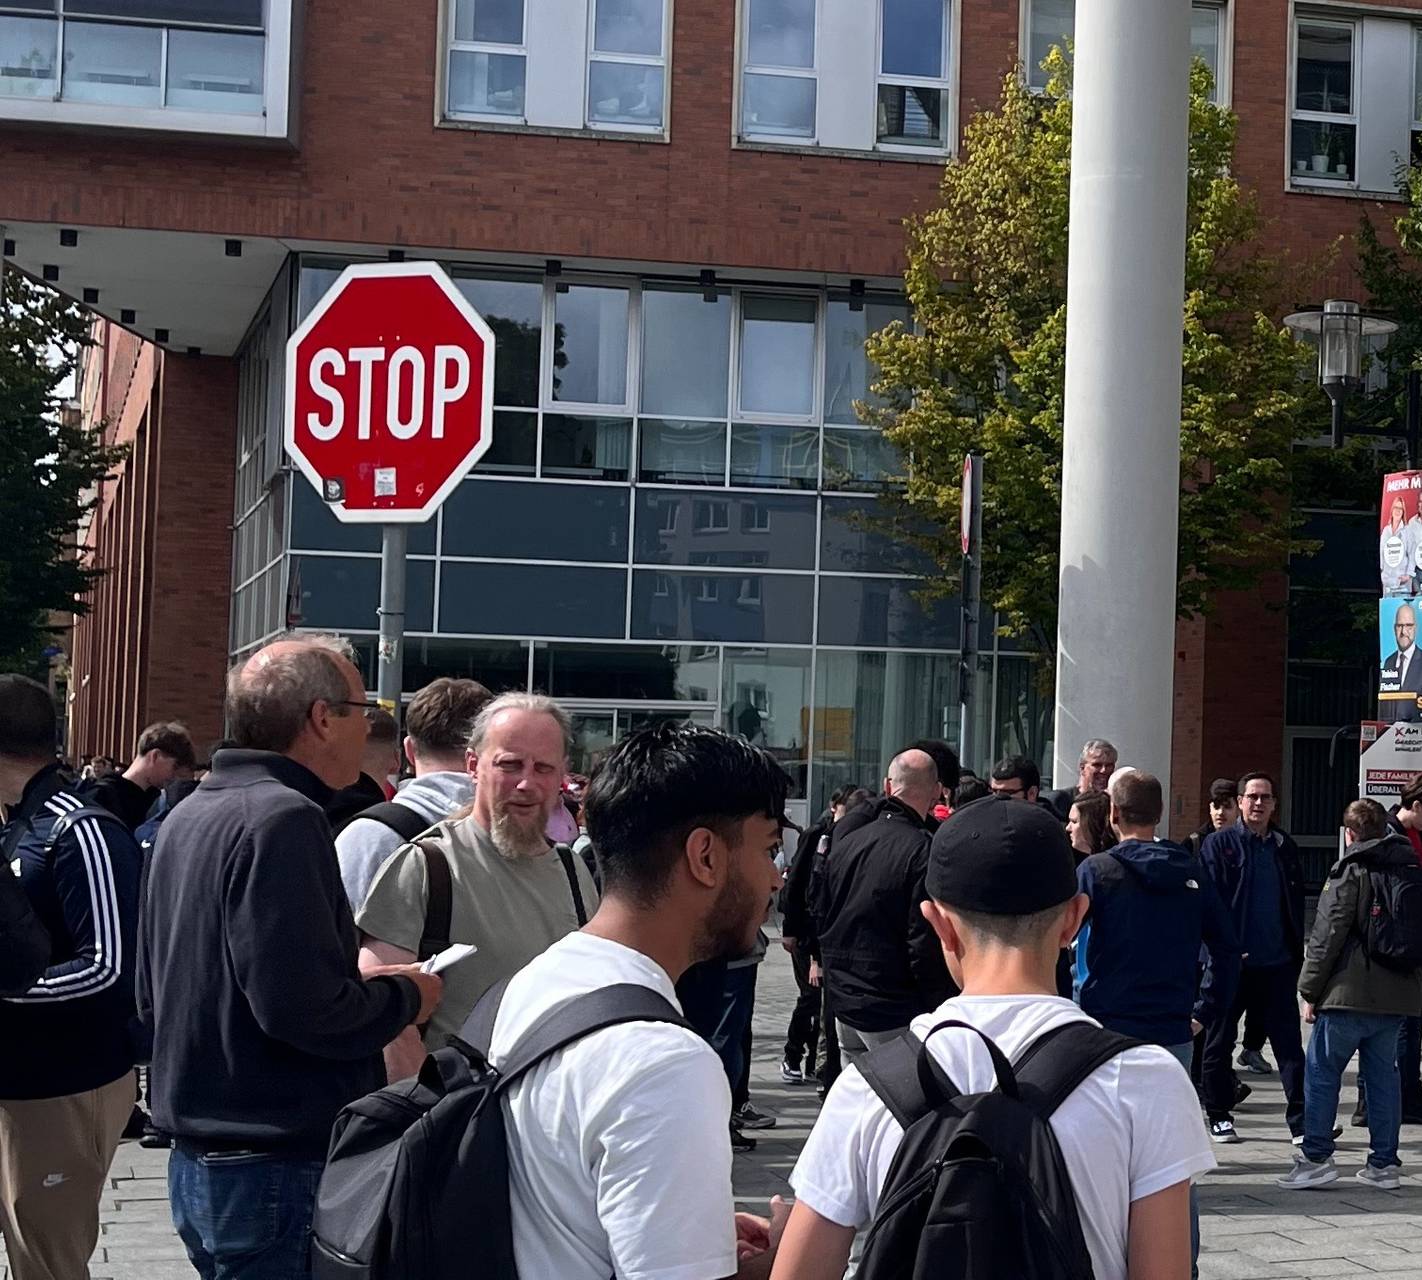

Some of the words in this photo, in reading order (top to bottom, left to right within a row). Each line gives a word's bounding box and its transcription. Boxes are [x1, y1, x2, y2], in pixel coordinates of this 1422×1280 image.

[307, 345, 470, 441] STOP
[1386, 478, 1410, 492] MEHR
[1368, 772, 1387, 780] JEDE
